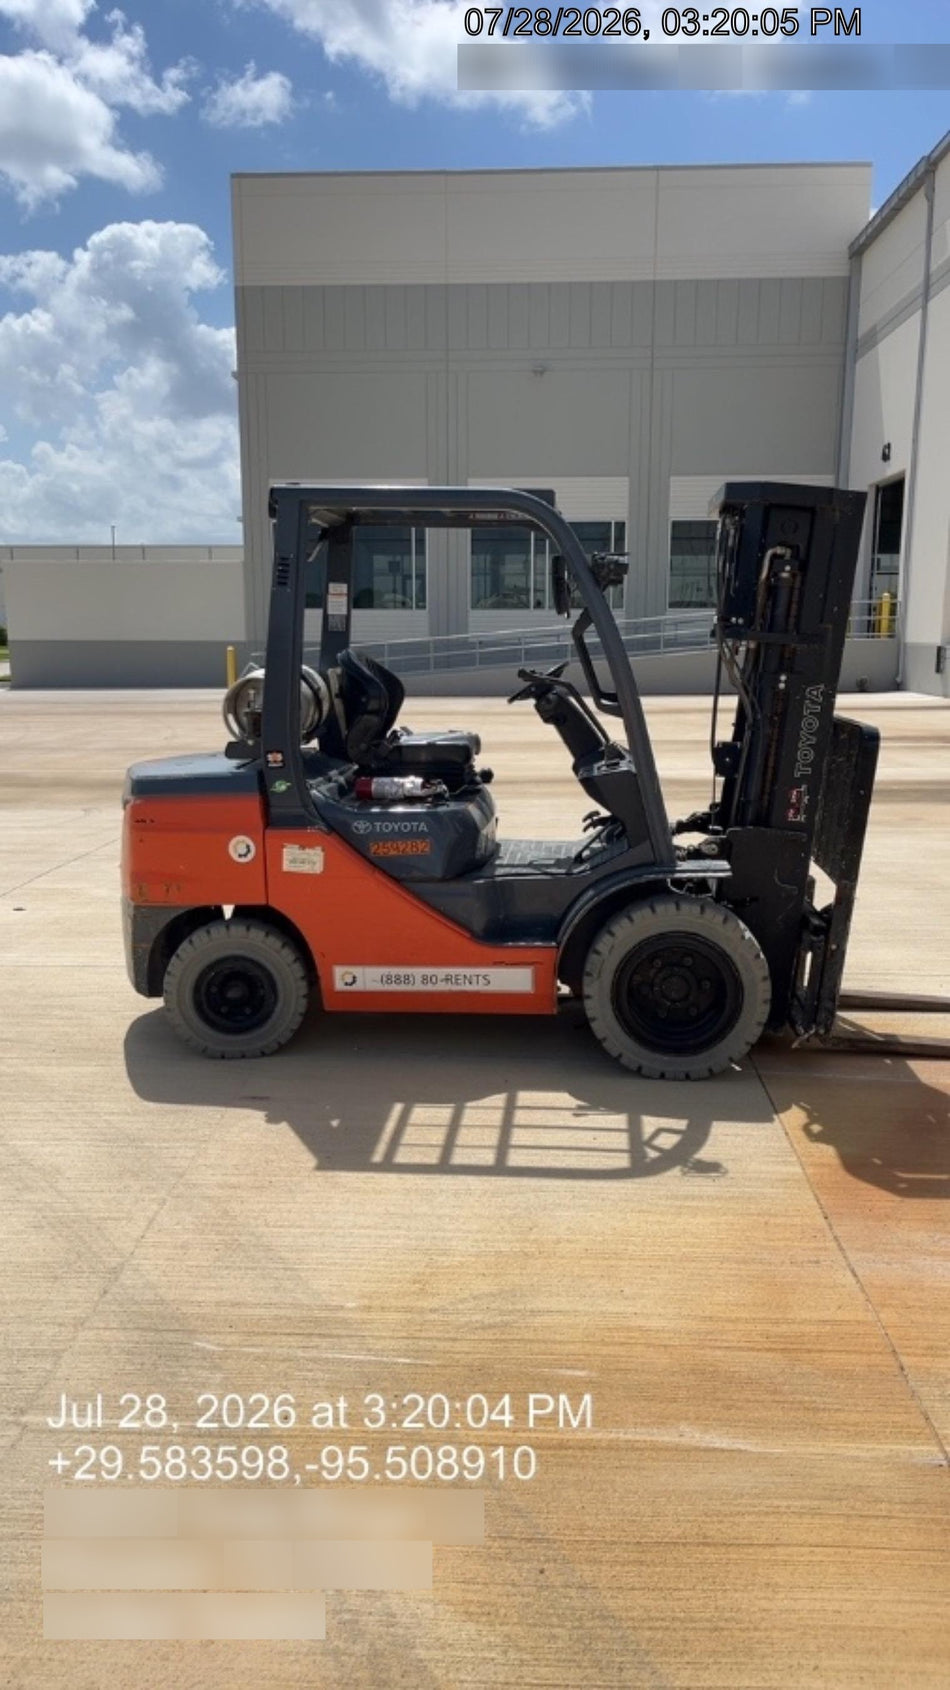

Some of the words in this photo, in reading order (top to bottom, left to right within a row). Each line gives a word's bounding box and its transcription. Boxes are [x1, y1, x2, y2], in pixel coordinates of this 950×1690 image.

[794, 683, 825, 778] TOYOTA
[373, 821, 429, 833] TOYOTA
[371, 840, 430, 856] 259282
